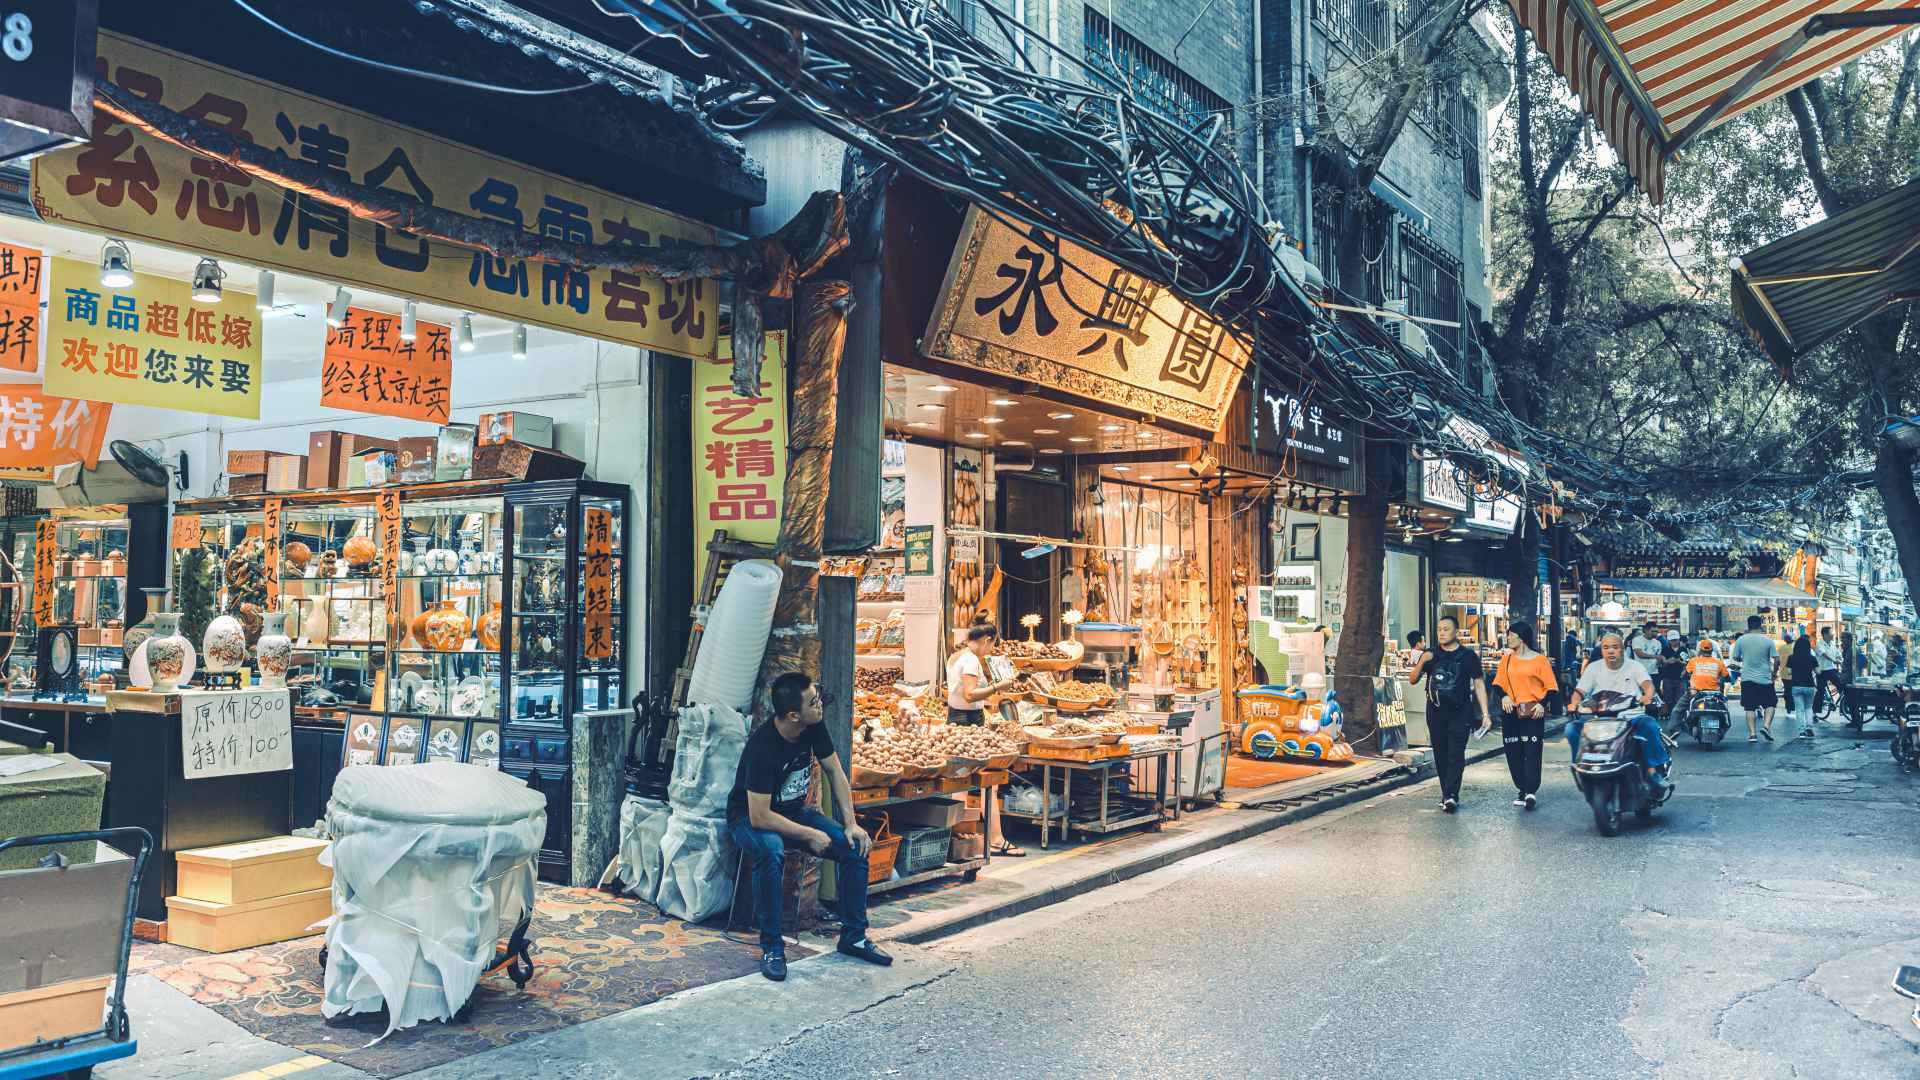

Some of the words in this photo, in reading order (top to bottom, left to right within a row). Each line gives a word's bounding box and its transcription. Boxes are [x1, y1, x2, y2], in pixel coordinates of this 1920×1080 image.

[64, 287, 253, 350] 商品超低嫁
[60, 337, 251, 395] 欢迎您来娶
[0, 396, 92, 451] 特价
